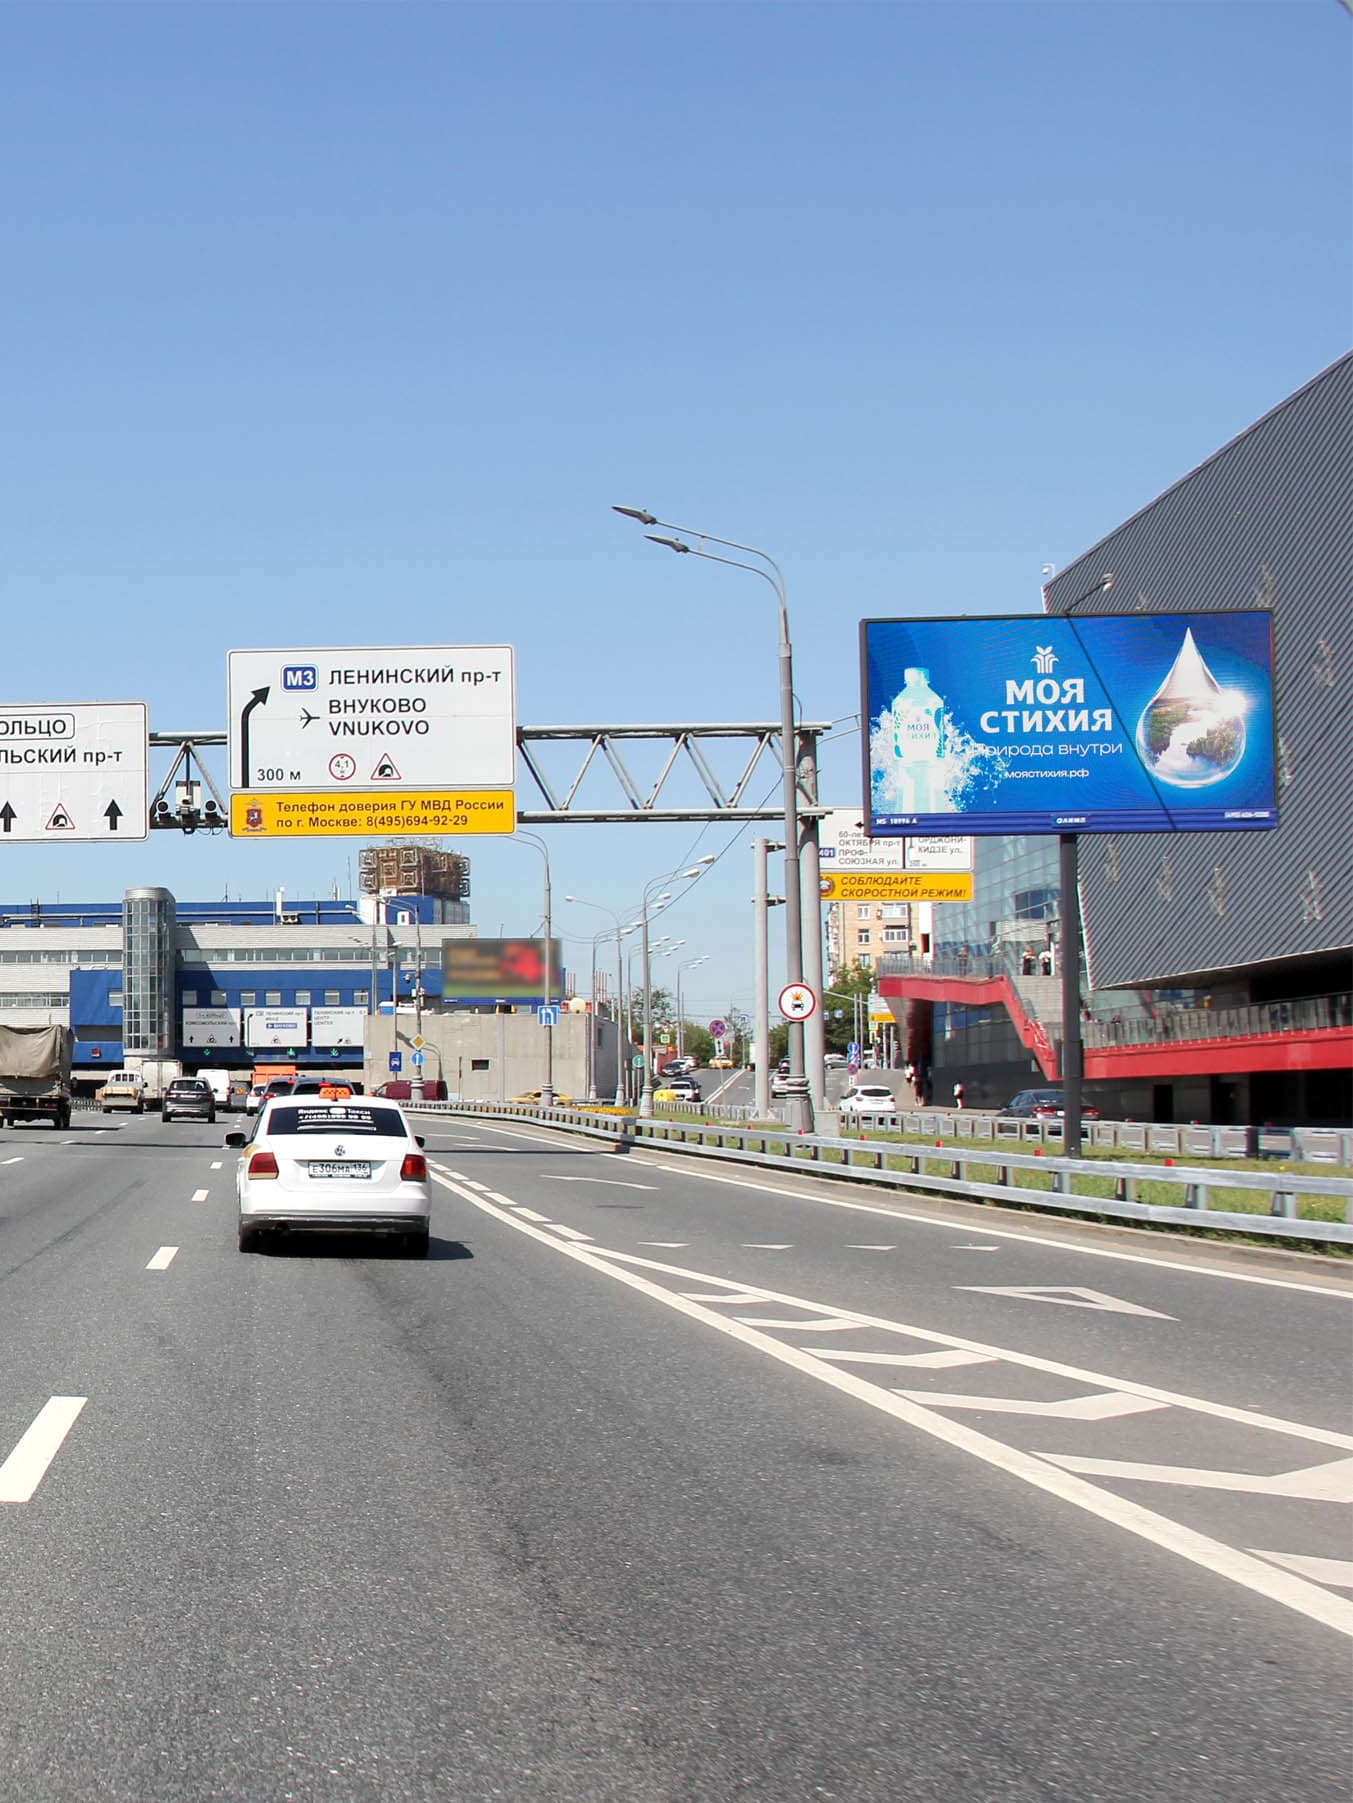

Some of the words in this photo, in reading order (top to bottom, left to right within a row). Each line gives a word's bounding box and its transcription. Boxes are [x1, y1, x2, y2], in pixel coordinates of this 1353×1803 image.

[286, 670, 314, 686] М3
[328, 665, 454, 685] ЛЕНИНСКИЙ
[461, 670, 501, 686] пр-т
[1005, 678, 1085, 705] МОЯ
[329, 697, 427, 714] ВНУКОВО
[328, 720, 430, 736] VNUKOVO
[980, 708, 1113, 733] СТИХИЯ
[1058, 743, 1123, 757] внутри
[83, 751, 123, 766] пр-т
[257, 769, 284, 781] 300
[289, 771, 301, 780] м
[1005, 768, 1090, 779] моястихия.рф
[276, 801, 335, 814] Телефон
[339, 802, 396, 813] доверия
[400, 800, 418, 811] ГУ
[421, 799, 451, 812] МВД
[456, 799, 504, 811] России
[276, 819, 293, 828] по
[297, 819, 305, 828] г.
[308, 817, 362, 828] Москве:
[366, 815, 468, 828] 8(495)694-92-29
[841, 876, 922, 886] СОБЛЮДАЙТЕ
[841, 887, 918, 897] СКОРОСТНОЙ
[921, 888, 966, 897] РЕЖИМ!
